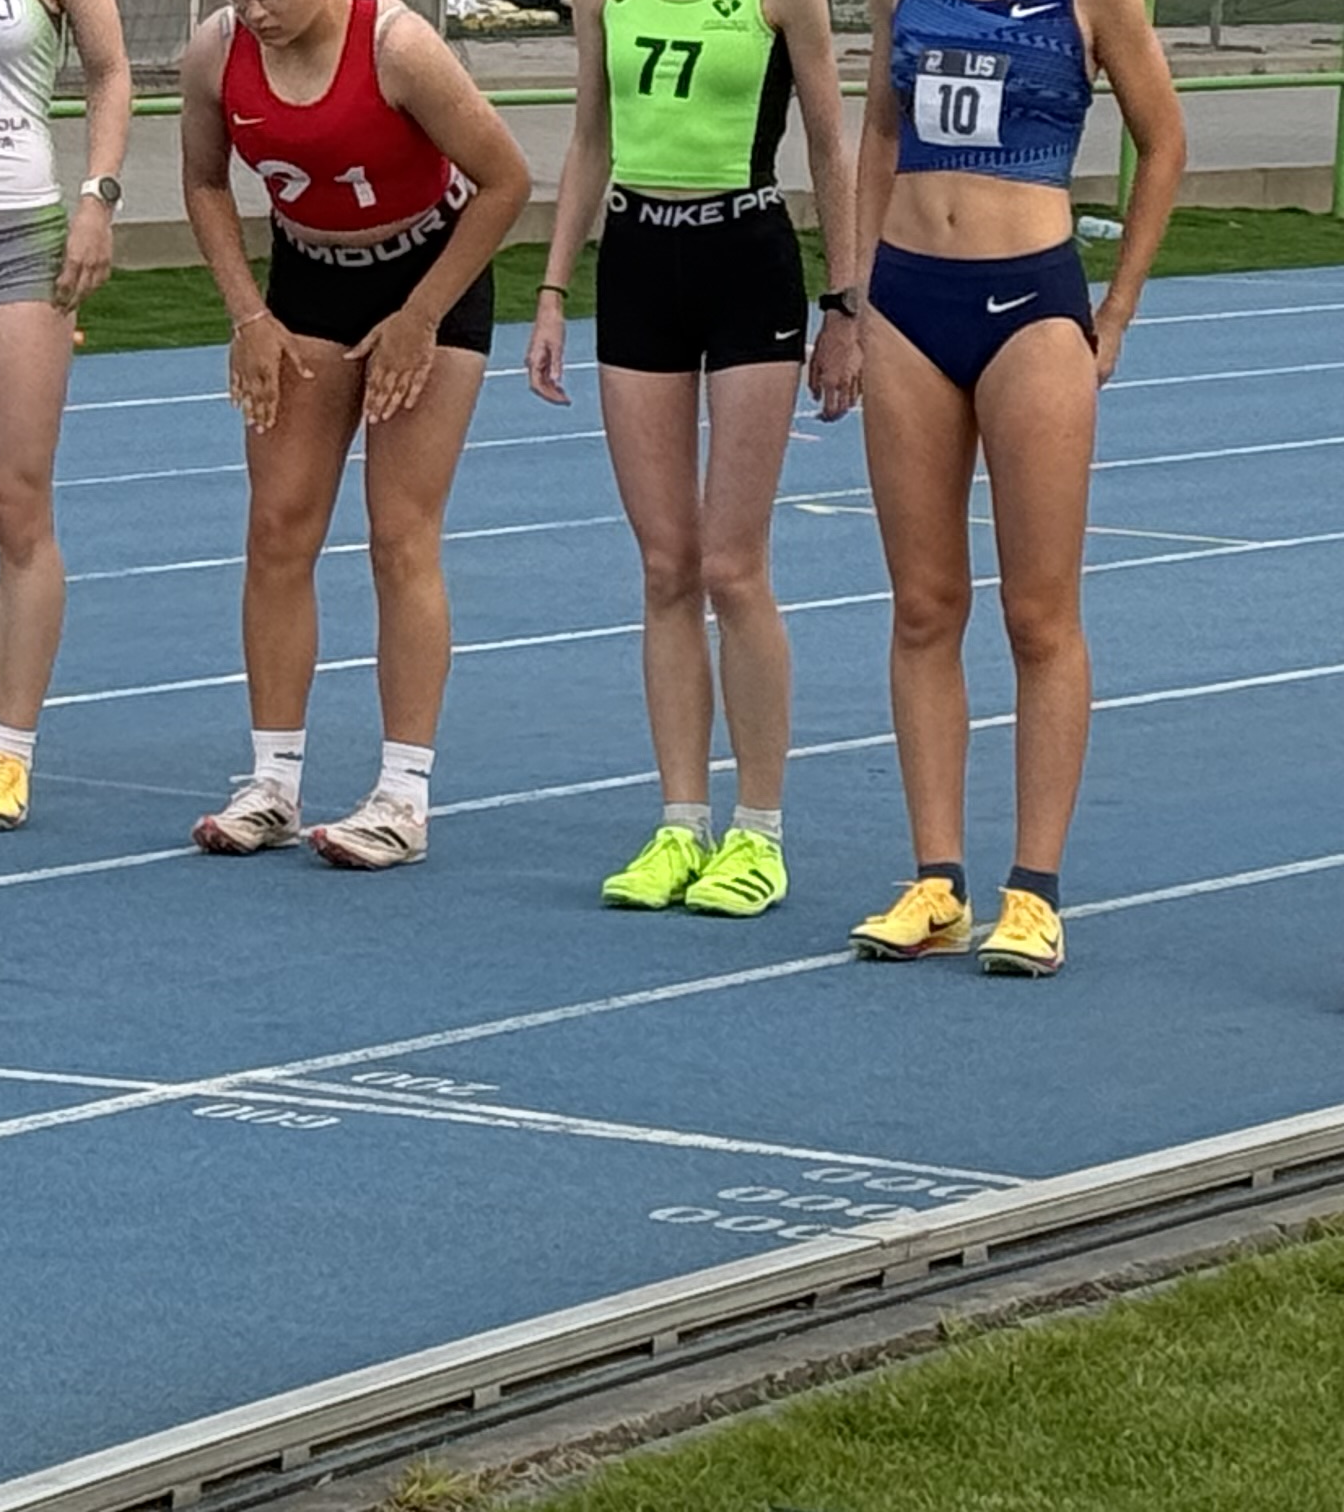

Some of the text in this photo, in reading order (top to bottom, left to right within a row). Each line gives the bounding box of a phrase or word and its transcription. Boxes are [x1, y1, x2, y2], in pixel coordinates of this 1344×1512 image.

[635, 36, 703, 99] 77
[938, 84, 980, 136] 10
[639, 202, 726, 227] NIKE
[352, 1071, 501, 1096] 200
[192, 1103, 341, 1129] 600
